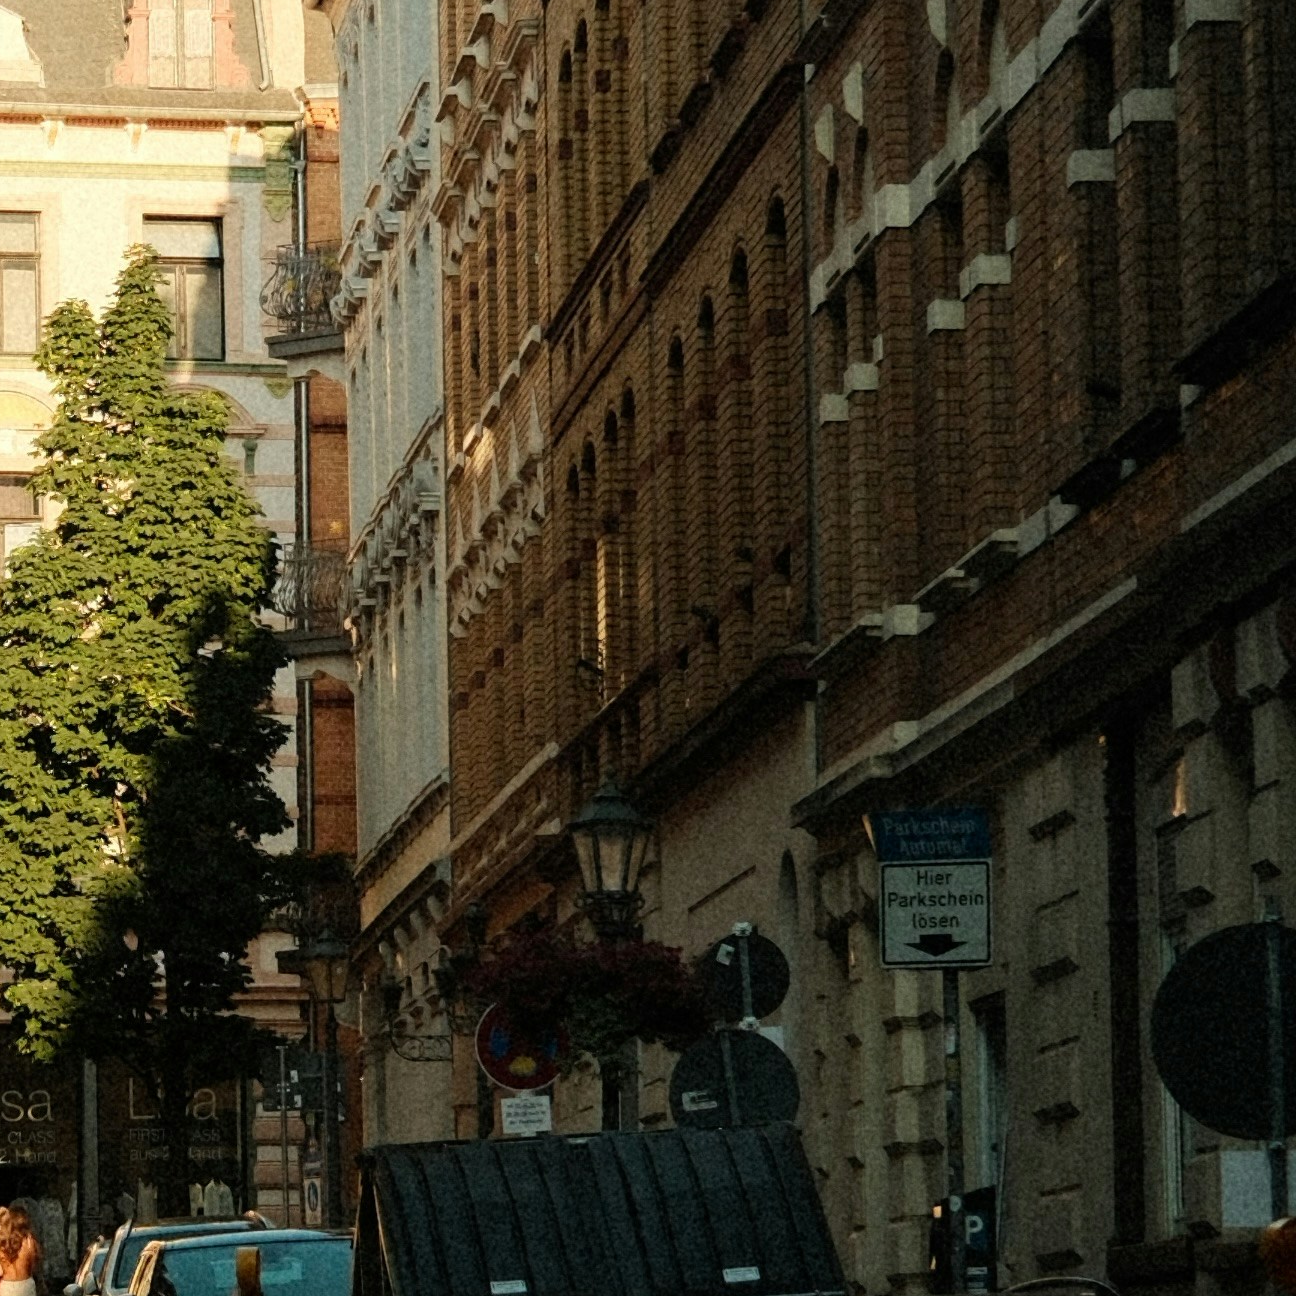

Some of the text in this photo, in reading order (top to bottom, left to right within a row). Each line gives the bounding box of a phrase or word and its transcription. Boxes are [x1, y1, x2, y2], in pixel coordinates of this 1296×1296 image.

[916, 870, 953, 885] Hier
[887, 890, 985, 908] Parkschein
[912, 912, 959, 929] lösen
[7, 1130, 56, 1145] CLASS
[15, 1148, 56, 1164] Hand
[965, 1215, 984, 1245] P
